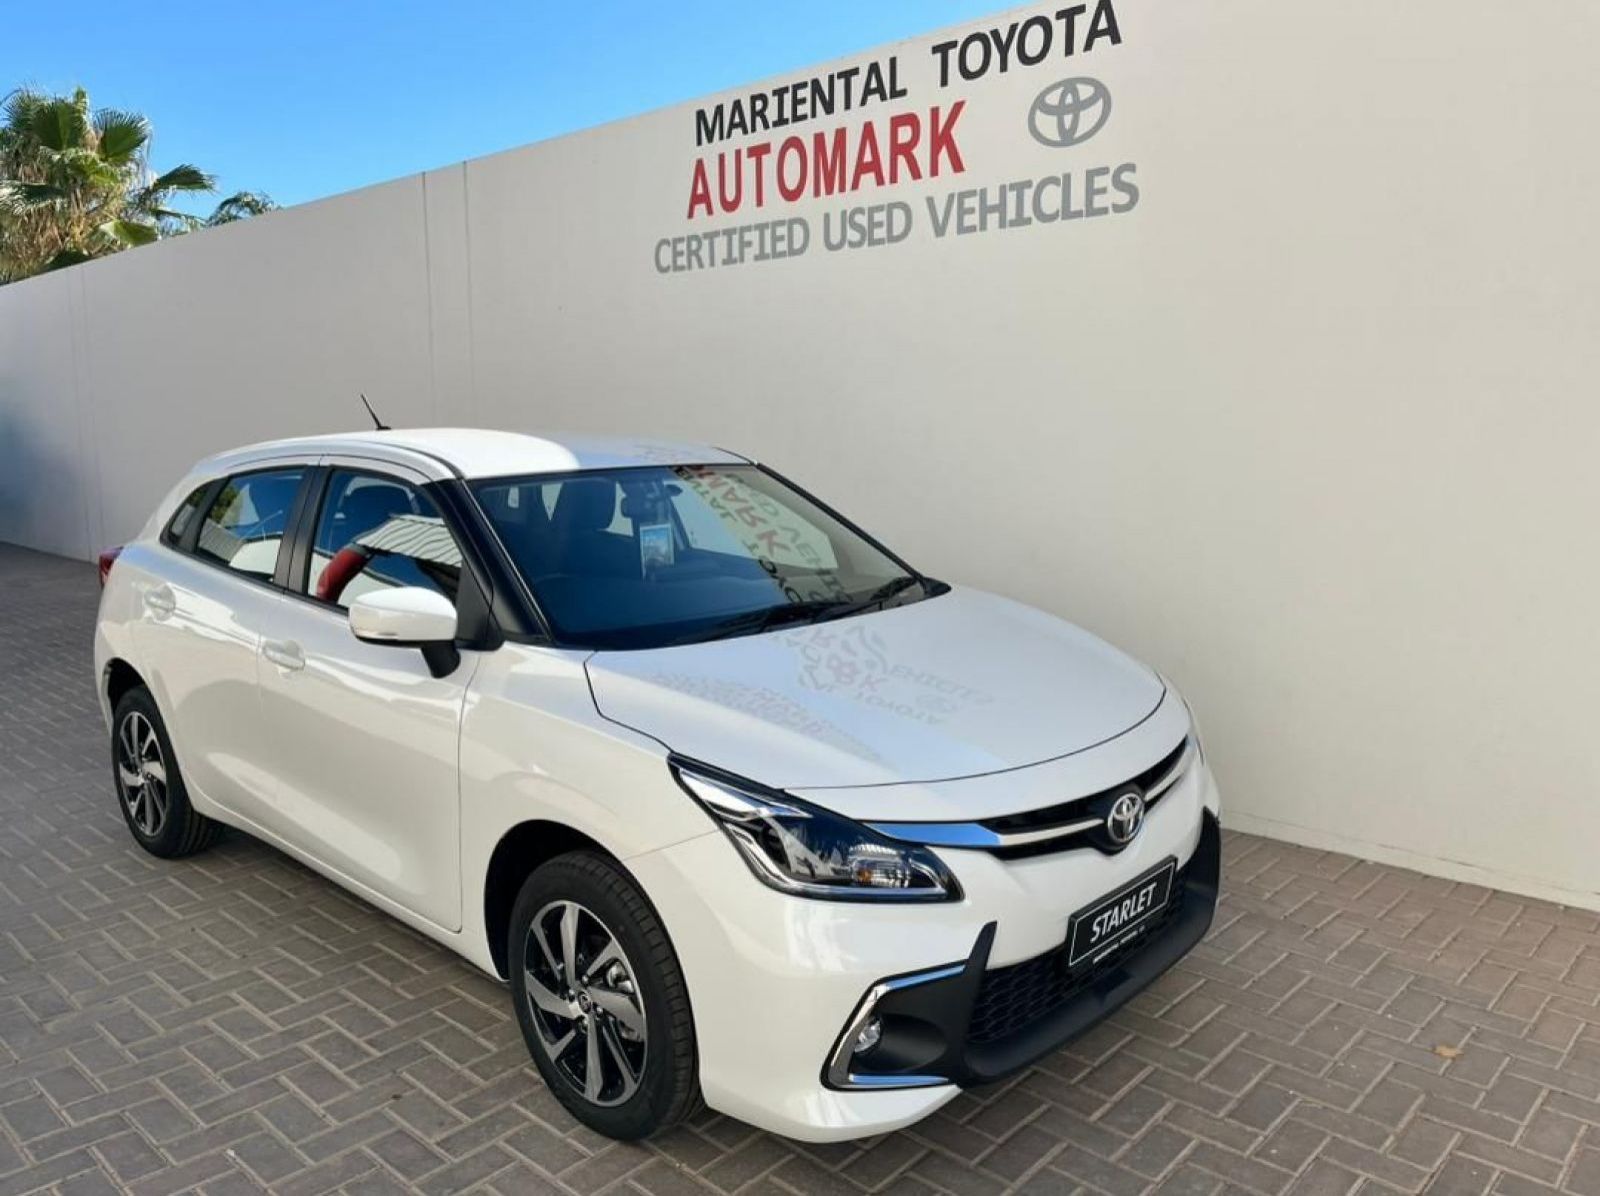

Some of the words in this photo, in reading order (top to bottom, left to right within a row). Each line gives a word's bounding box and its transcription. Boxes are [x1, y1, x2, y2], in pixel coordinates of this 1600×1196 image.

[695, 57, 907, 147] MARIENTAL
[931, 0, 1122, 88] TOYOTA
[687, 100, 966, 220] AUTOMARK
[654, 217, 810, 274] CERTIFIED
[824, 201, 912, 252] USED
[926, 163, 1139, 238] VEHICLES
[1090, 882, 1157, 943] STARLET
